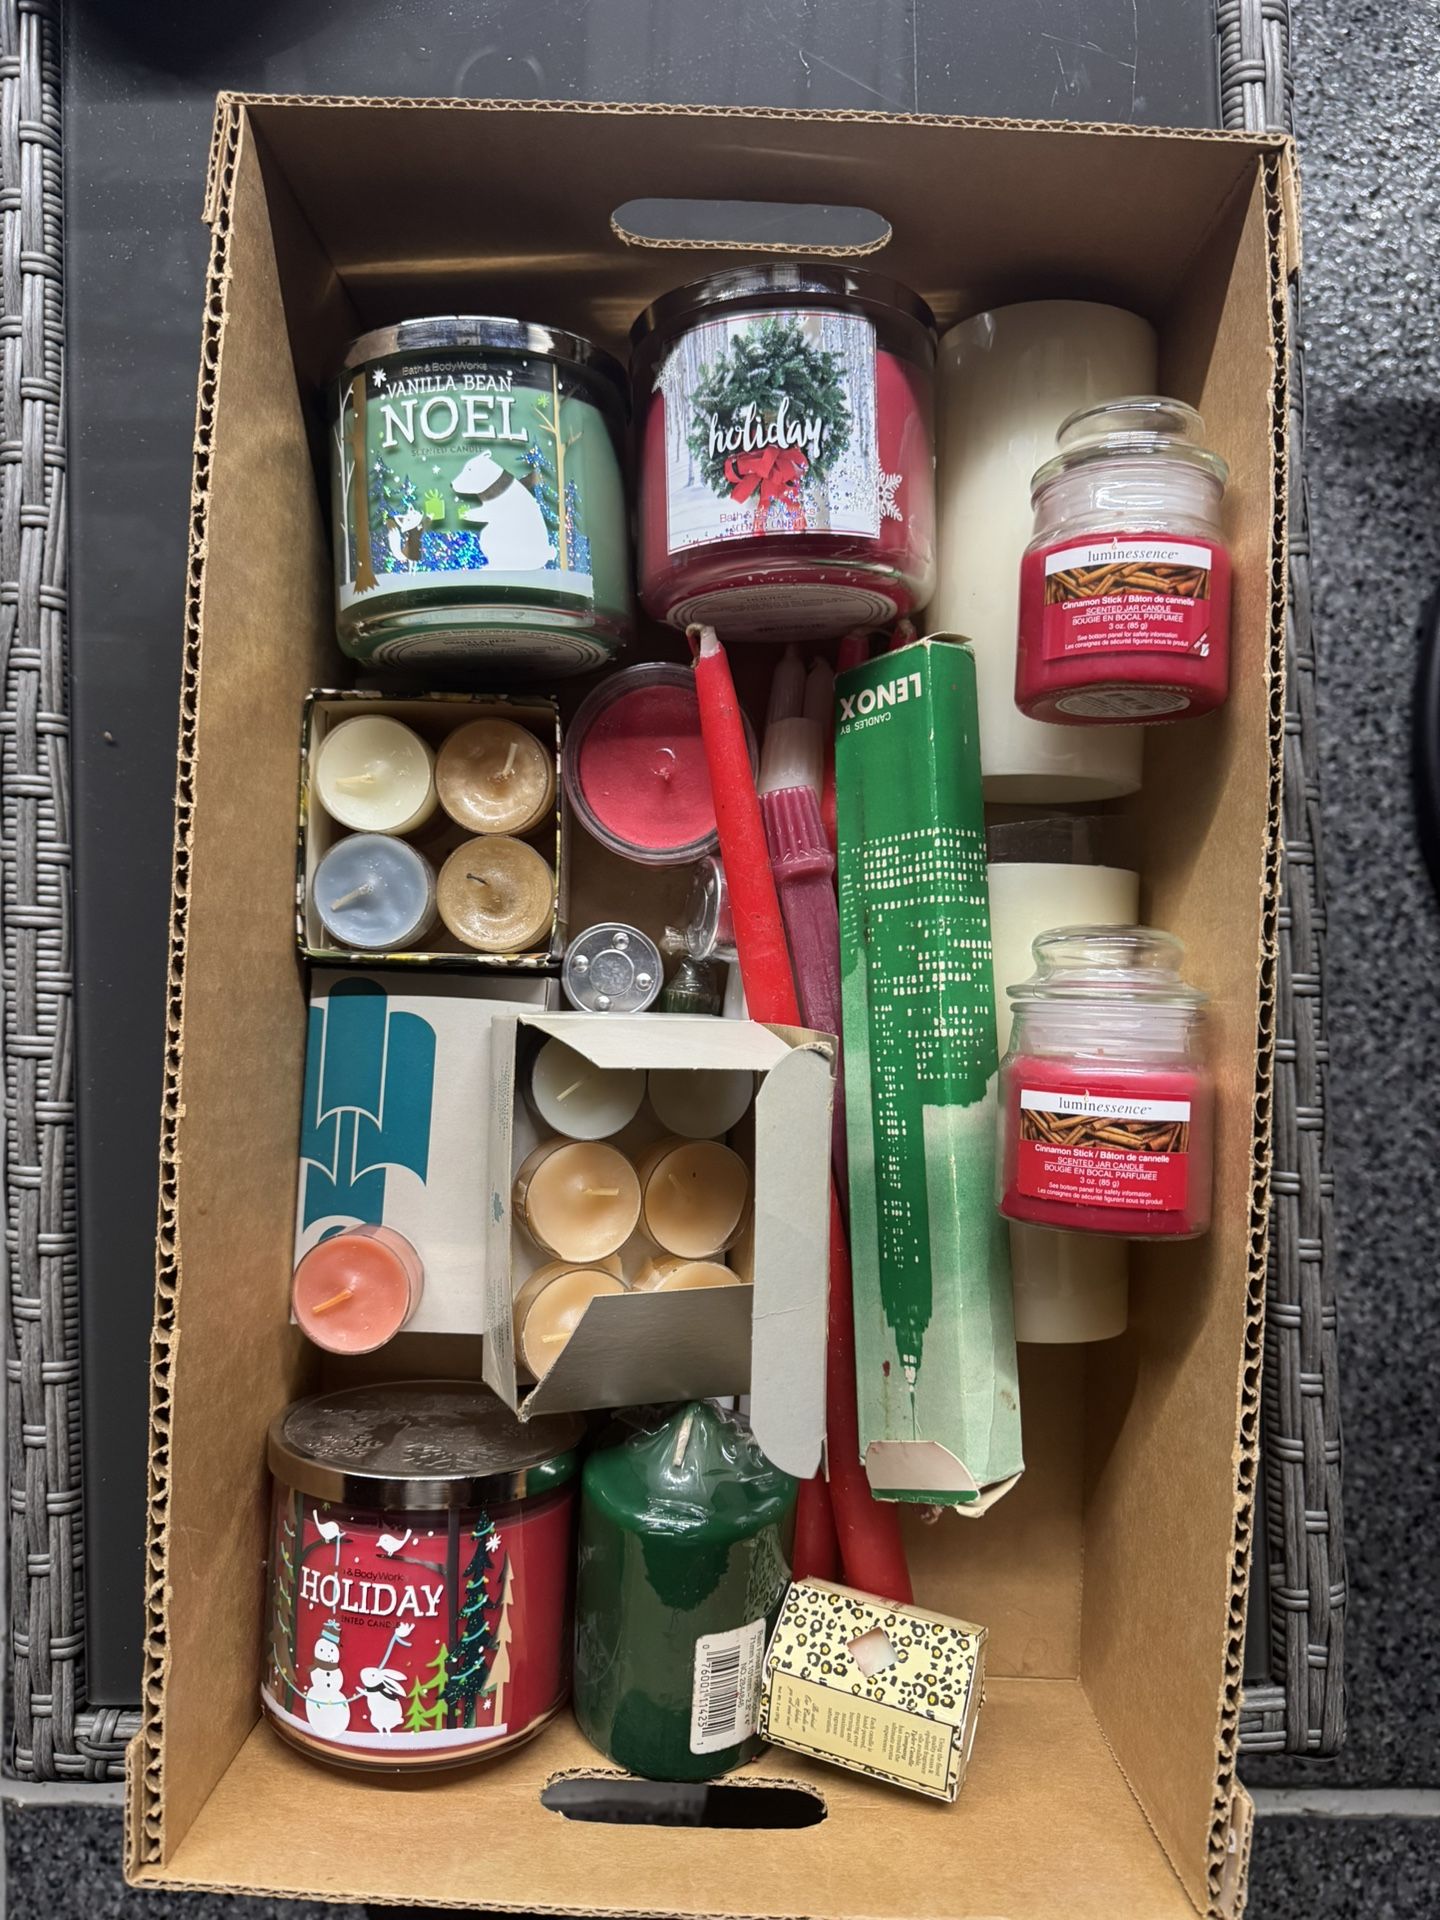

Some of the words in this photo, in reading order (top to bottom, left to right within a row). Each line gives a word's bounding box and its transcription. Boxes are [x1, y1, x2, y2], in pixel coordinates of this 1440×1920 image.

[402, 365, 424, 376] Bath
[424, 363, 431, 373] &
[386, 376, 458, 399] VANILLA
[463, 374, 513, 393] BEAN
[380, 395, 529, 448] NOEL
[708, 396, 822, 459] holiday
[720, 511, 743, 523] Bath
[1062, 598, 1101, 610] Cinnamon
[1101, 595, 1123, 604] Stick
[1128, 594, 1153, 603] Bâton
[1153, 595, 1164, 603] de
[1165, 597, 1194, 606] cannelle
[1086, 605, 1123, 615] SCENTED
[1123, 604, 1140, 612] JAR
[1140, 604, 1171, 612] CANDLE
[1072, 615, 1101, 626] BOUGIE
[1115, 613, 1142, 622] BOCAL
[1108, 622, 1114, 630] 3
[1107, 631, 1123, 639] panel
[1132, 630, 1150, 638] safety
[840, 672, 922, 722] LENOX
[854, 711, 892, 731] CANDLES
[840, 724, 851, 736] BY
[1034, 1143, 1072, 1156] Cinnamon
[1073, 1148, 1094, 1158] Stick
[1126, 1153, 1137, 1161] de
[1138, 1155, 1170, 1163] cannelle
[1044, 1163, 1072, 1174] BOUGIE
[1073, 1167, 1085, 1175] EN
[1086, 1168, 1114, 1178] BOCAL
[1057, 1156, 1094, 1167] SCENTED
[1095, 1160, 1111, 1169] JAR
[1112, 1161, 1145, 1171] CANDLE
[1079, 1176, 1085, 1184] 3
[1059, 1183, 1078, 1191] bottom
[1104, 1188, 1121, 1196] safety
[1121, 1190, 1152, 1198] information
[346, 1567, 353, 1576] &
[300, 1565, 444, 1617] HOLIDAY
